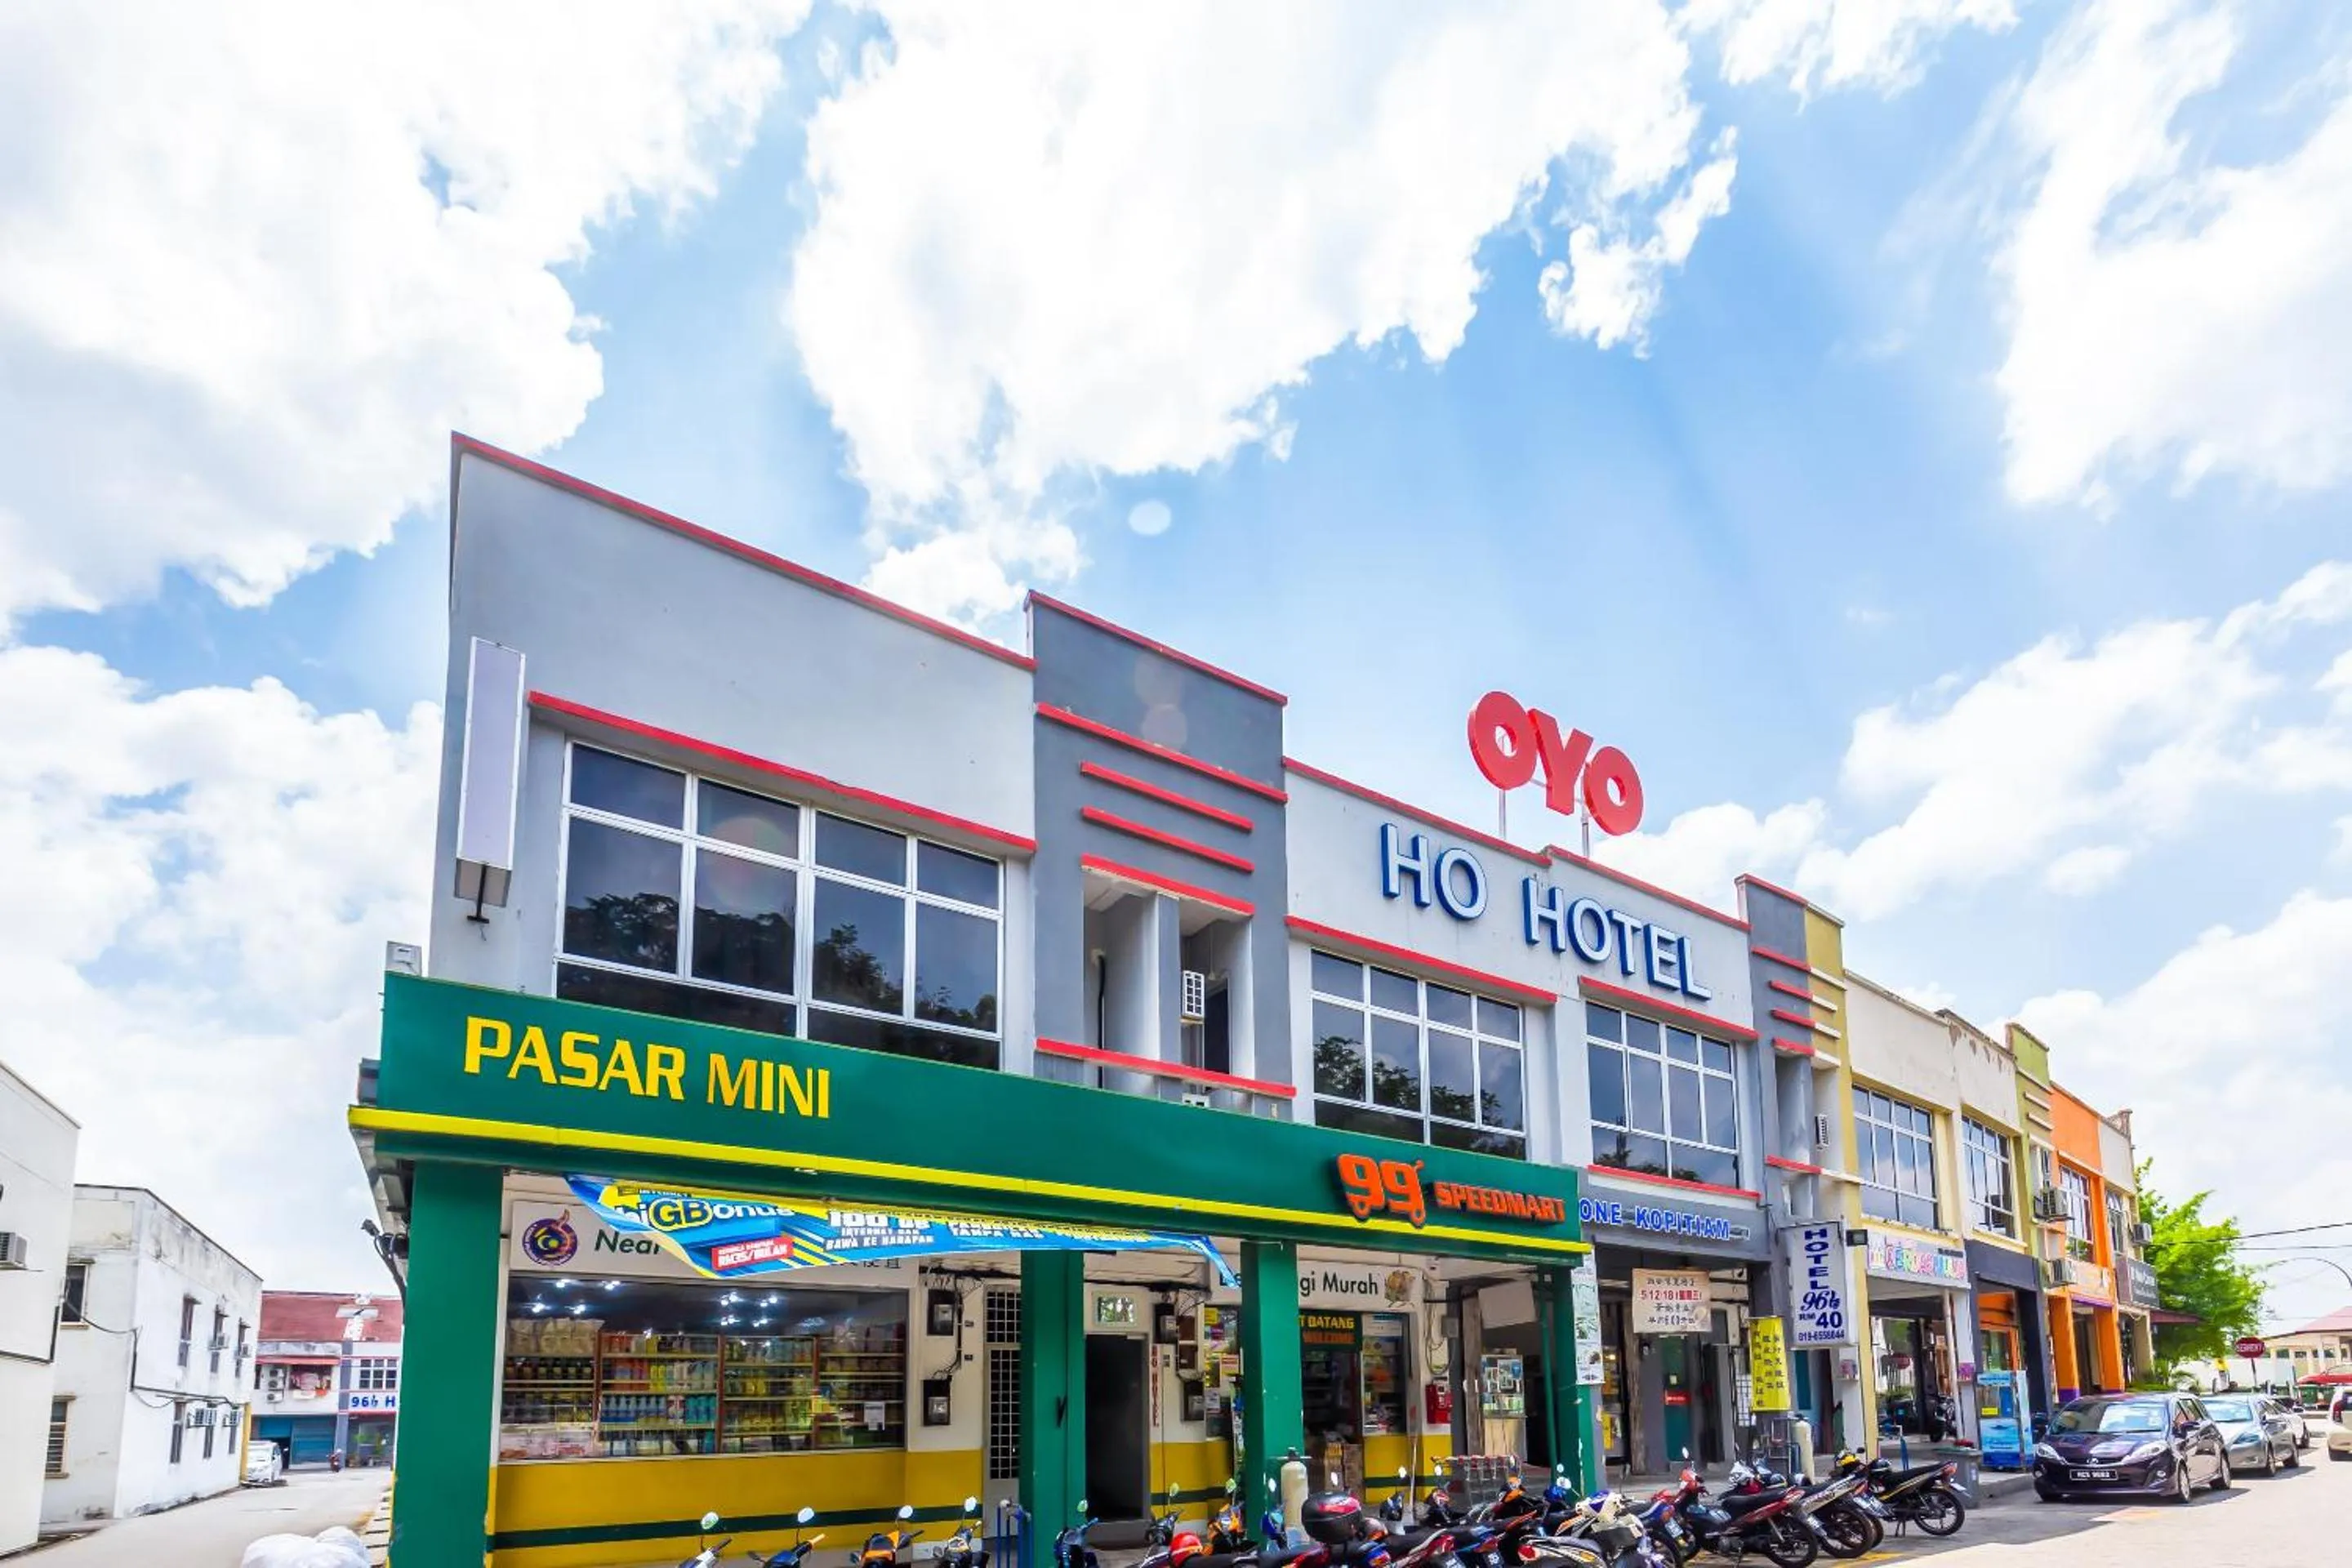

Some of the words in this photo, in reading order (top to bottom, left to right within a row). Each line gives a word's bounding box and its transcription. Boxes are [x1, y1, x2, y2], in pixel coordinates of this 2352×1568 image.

[1468, 690, 1644, 836] OYO
[1380, 822, 1487, 920] HO
[1523, 877, 1712, 1000] HOTEL
[463, 1016, 686, 1101] PASAR
[705, 1053, 831, 1119] MINI
[1337, 1153, 1426, 1227] 99
[1433, 1181, 1566, 1223] SPEEDMART
[1579, 1197, 1624, 1225] ONE
[1635, 1205, 1731, 1241] KOPITIAM
[1323, 1271, 1379, 1295] Murah
[1804, 1227, 1829, 1290] HOTEL
[1308, 1316, 1355, 1329] BATANG
[1815, 1311, 1843, 1329] 40
